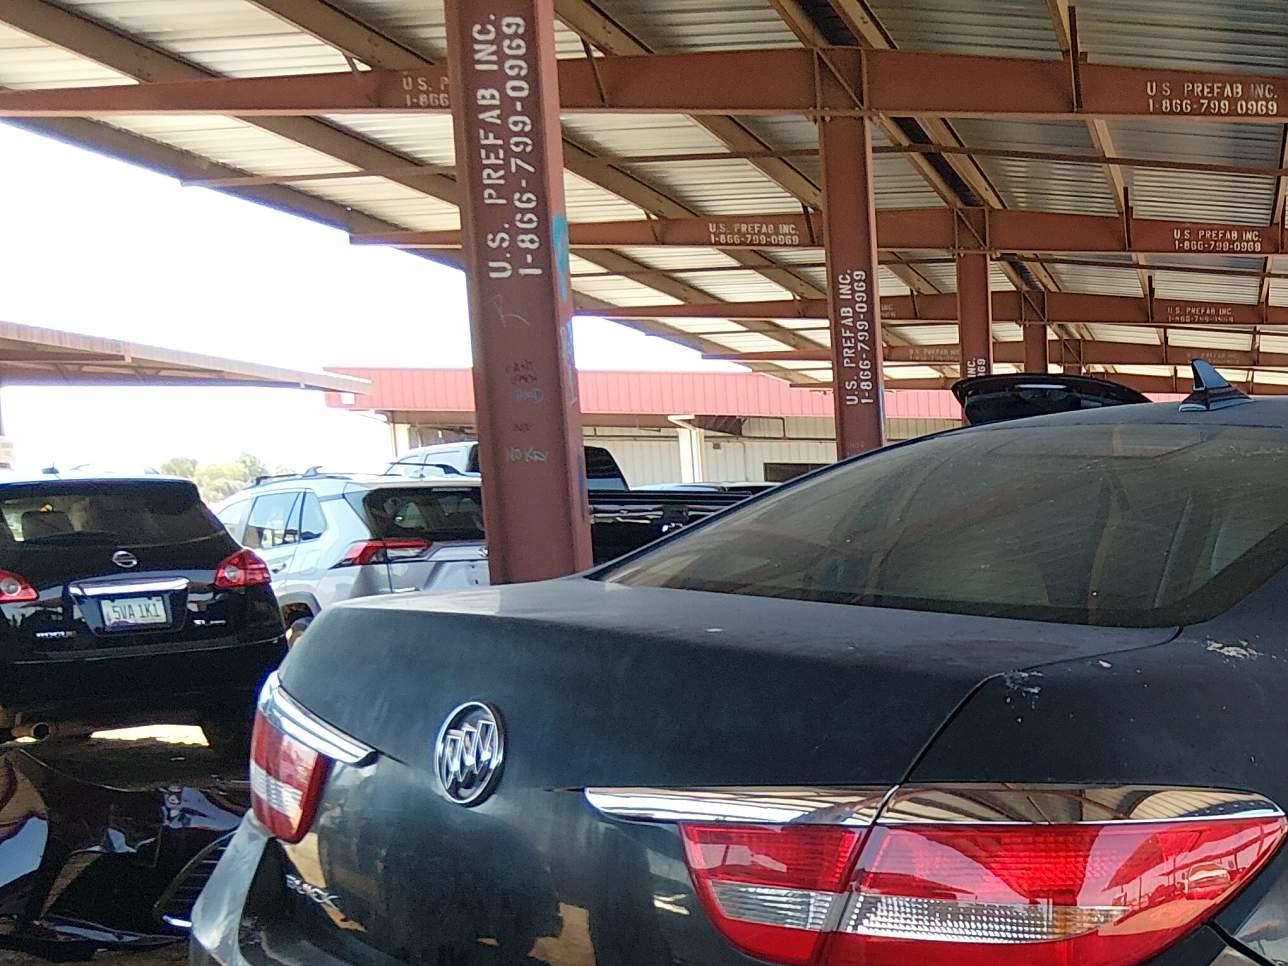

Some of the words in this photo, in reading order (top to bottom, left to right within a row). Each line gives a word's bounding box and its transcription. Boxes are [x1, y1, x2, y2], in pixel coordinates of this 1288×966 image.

[472, 14, 498, 71] INC.
[1184, 82, 1242, 98] PREFAB
[1250, 83, 1278, 99] INC.
[477, 87, 507, 204] PREFAB
[501, 16, 543, 275] 1-866-799-0969
[487, 223, 512, 279] U.S.
[734, 223, 774, 234] PREFAB
[779, 224, 800, 235] INC.
[1198, 230, 1238, 241] PREFAB
[1242, 231, 1262, 241] INC.
[838, 269, 852, 299] INC.
[840, 307, 856, 367] PREFAB
[853, 270, 874, 404] 1-866-799-0969
[285, 874, 342, 911] BUICK
